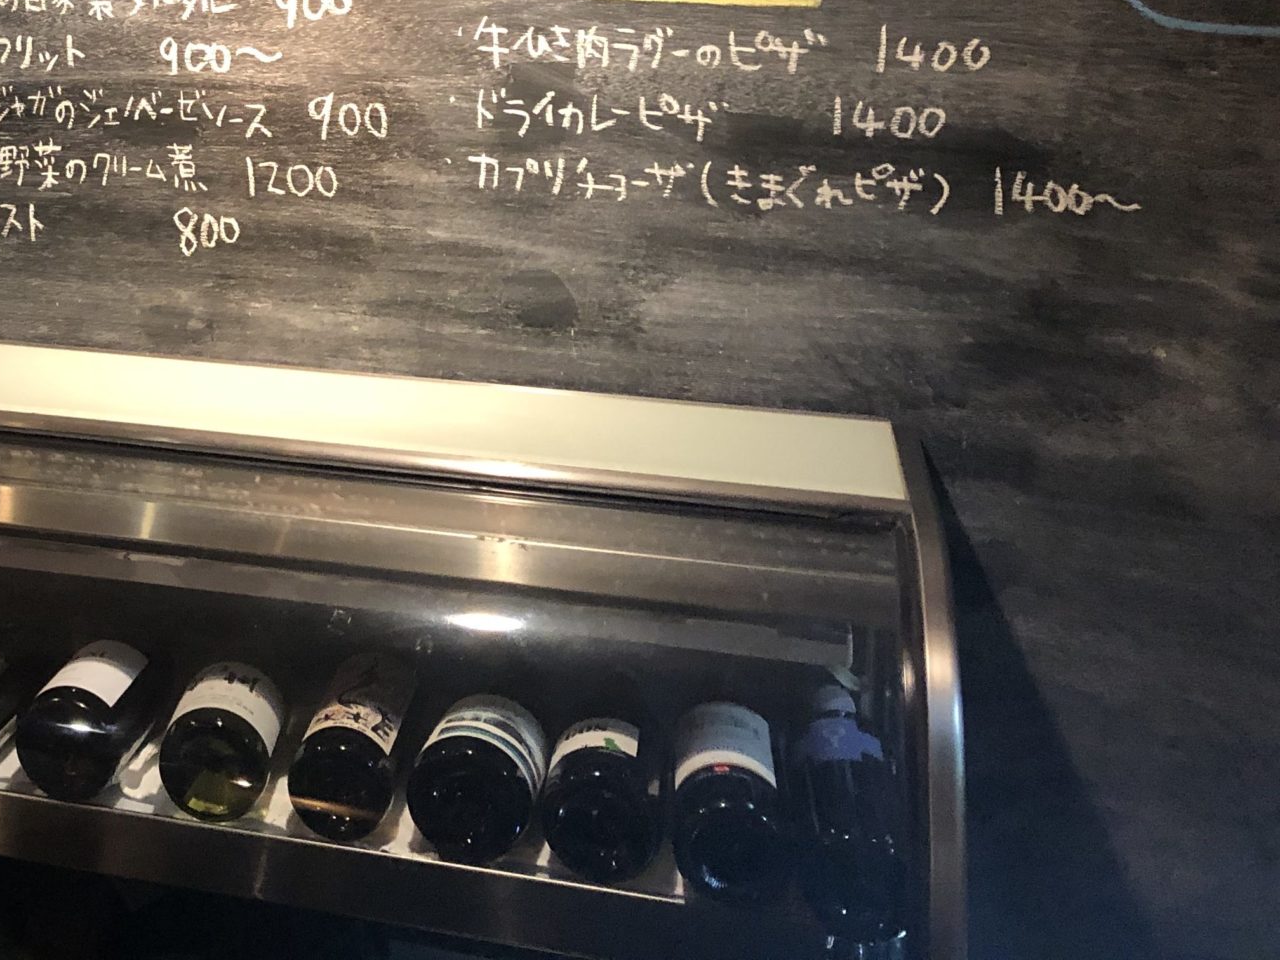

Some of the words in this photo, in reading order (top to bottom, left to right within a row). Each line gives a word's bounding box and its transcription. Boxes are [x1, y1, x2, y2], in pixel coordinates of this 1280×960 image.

[876, 24, 992, 74] 1400
[308, 91, 389, 140] 900
[475, 90, 730, 141] ドライカレーピザ
[833, 95, 946, 138] 1400
[245, 156, 339, 200] 1200
[172, 206, 240, 257] 800
